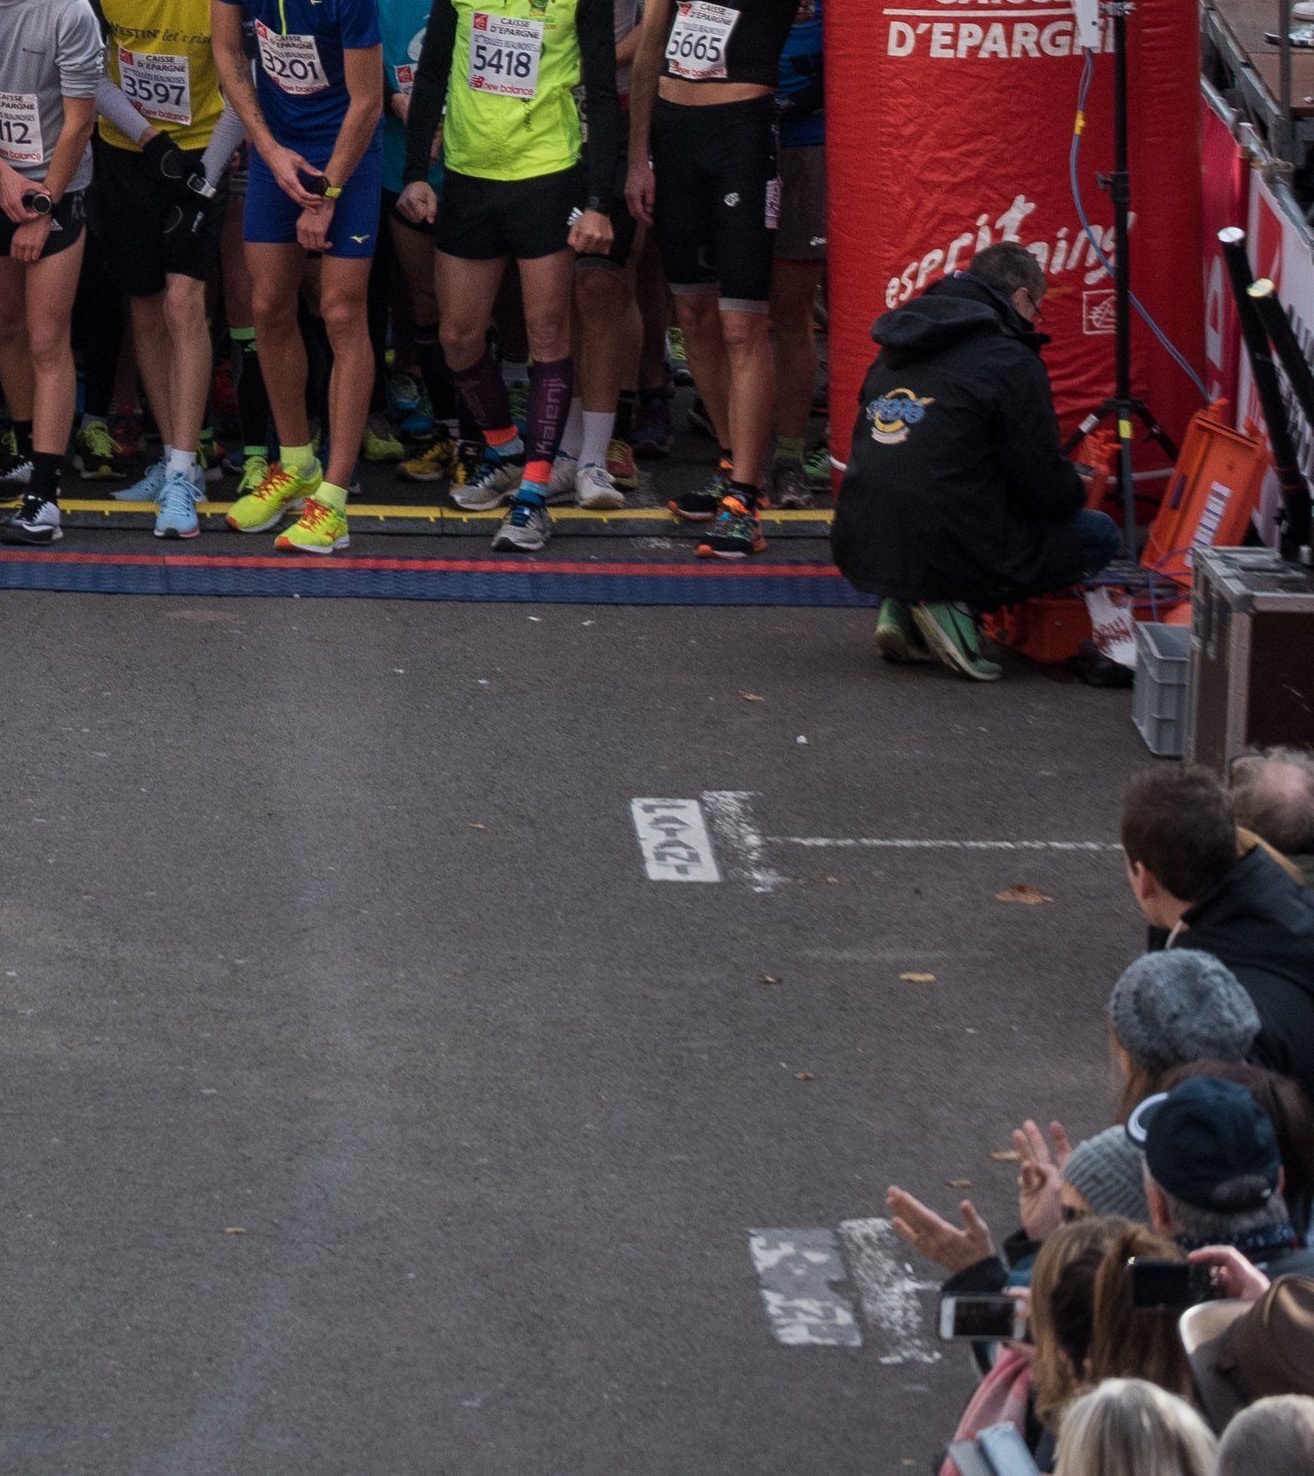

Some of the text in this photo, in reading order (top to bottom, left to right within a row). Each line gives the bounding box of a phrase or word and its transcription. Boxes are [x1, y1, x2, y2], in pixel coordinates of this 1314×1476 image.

[500, 17, 530, 28] CAISSE
[145, 55, 175, 63] CAISSE
[473, 44, 531, 78] 5418
[668, 31, 721, 63] 5665
[263, 49, 319, 80] 3201
[123, 74, 186, 106] 3597
